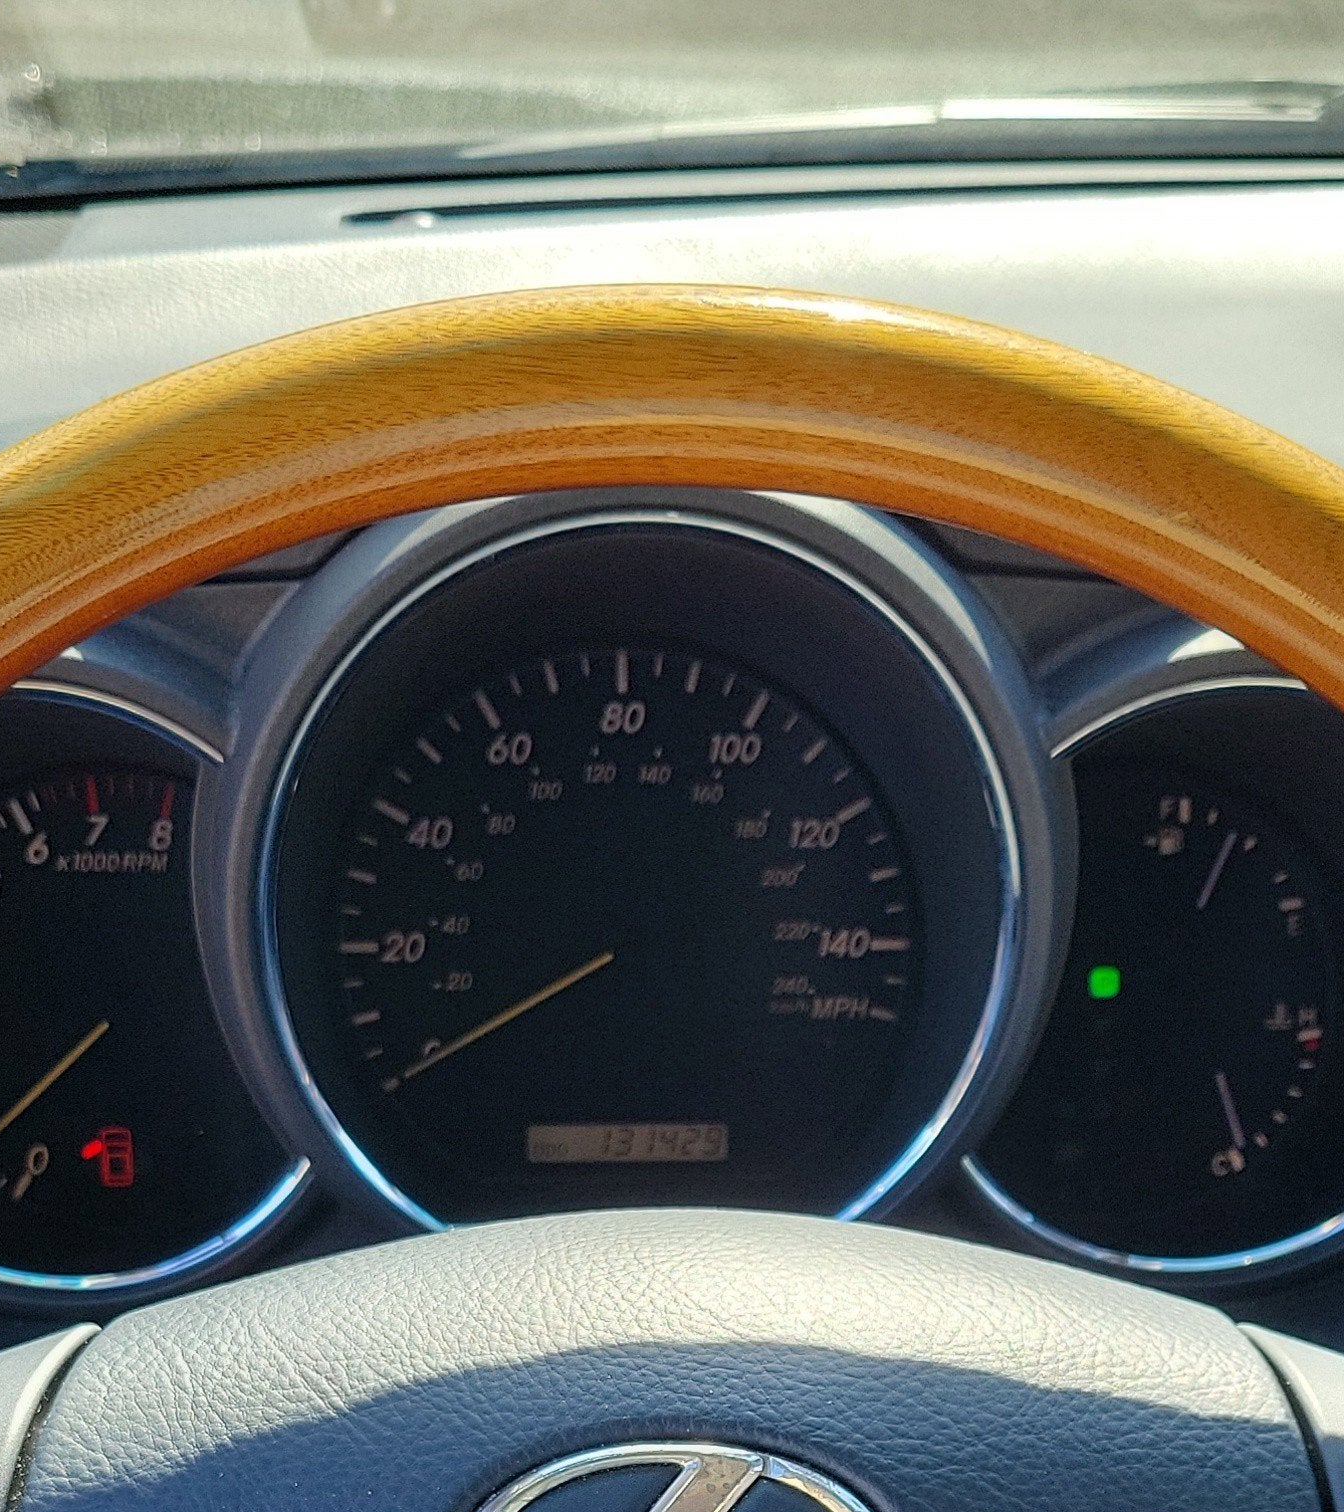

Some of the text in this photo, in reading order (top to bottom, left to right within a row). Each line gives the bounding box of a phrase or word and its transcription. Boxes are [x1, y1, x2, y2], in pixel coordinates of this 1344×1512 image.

[601, 702, 646, 734] 80
[488, 733, 532, 765] 60
[709, 733, 762, 765] 100
[586, 761, 618, 785] 120
[639, 763, 673, 785] 140
[531, 780, 563, 801] 100
[86, 814, 110, 846] 7
[149, 818, 174, 851] 8
[409, 815, 453, 849] 40
[487, 813, 516, 835] 80
[789, 818, 840, 849] 120
[26, 832, 49, 865] 6
[457, 861, 484, 882] 60
[442, 914, 471, 935] 40
[381, 931, 426, 963] 20
[818, 929, 870, 959] 140
[446, 970, 474, 992] 20
[810, 998, 870, 1019] MPH
[26, 1142, 50, 1175] 0
